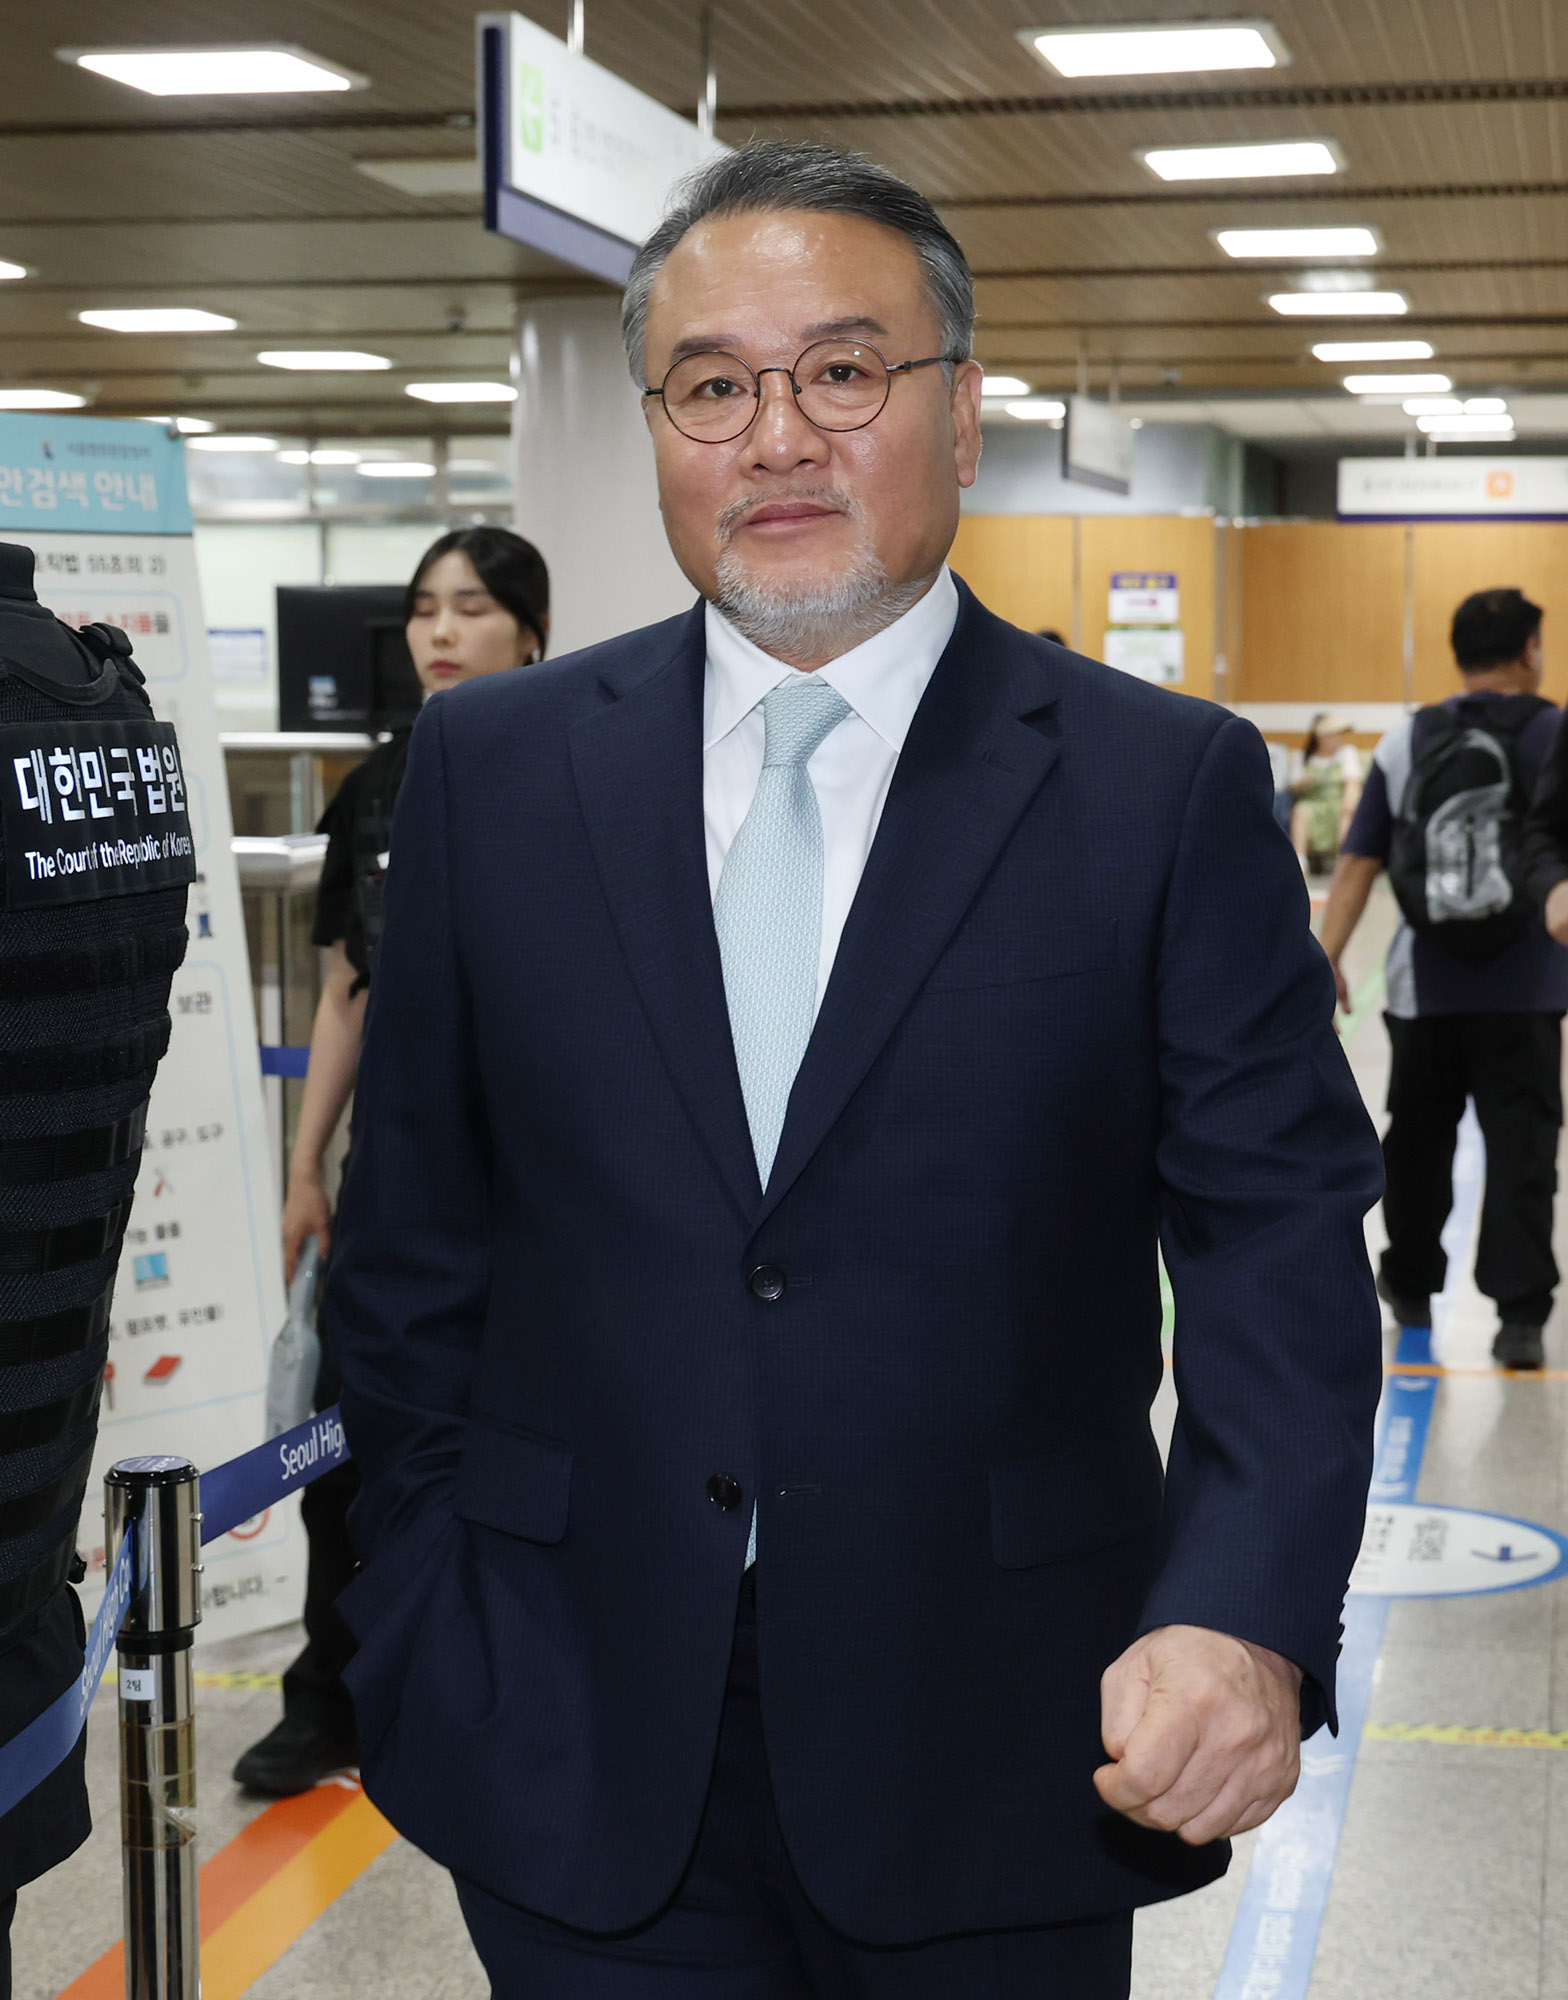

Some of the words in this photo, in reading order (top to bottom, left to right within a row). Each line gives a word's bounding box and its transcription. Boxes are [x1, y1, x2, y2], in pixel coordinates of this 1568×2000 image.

[94, 469, 158, 512] 안내
[25, 851, 56, 880] The
[56, 847, 92, 876] Court
[100, 841, 119, 869] the
[118, 834, 161, 870] Republic
[169, 832, 192, 857] Korea
[280, 1426, 318, 1480] Seoul
[126, 1679, 141, 1692] 2팀
